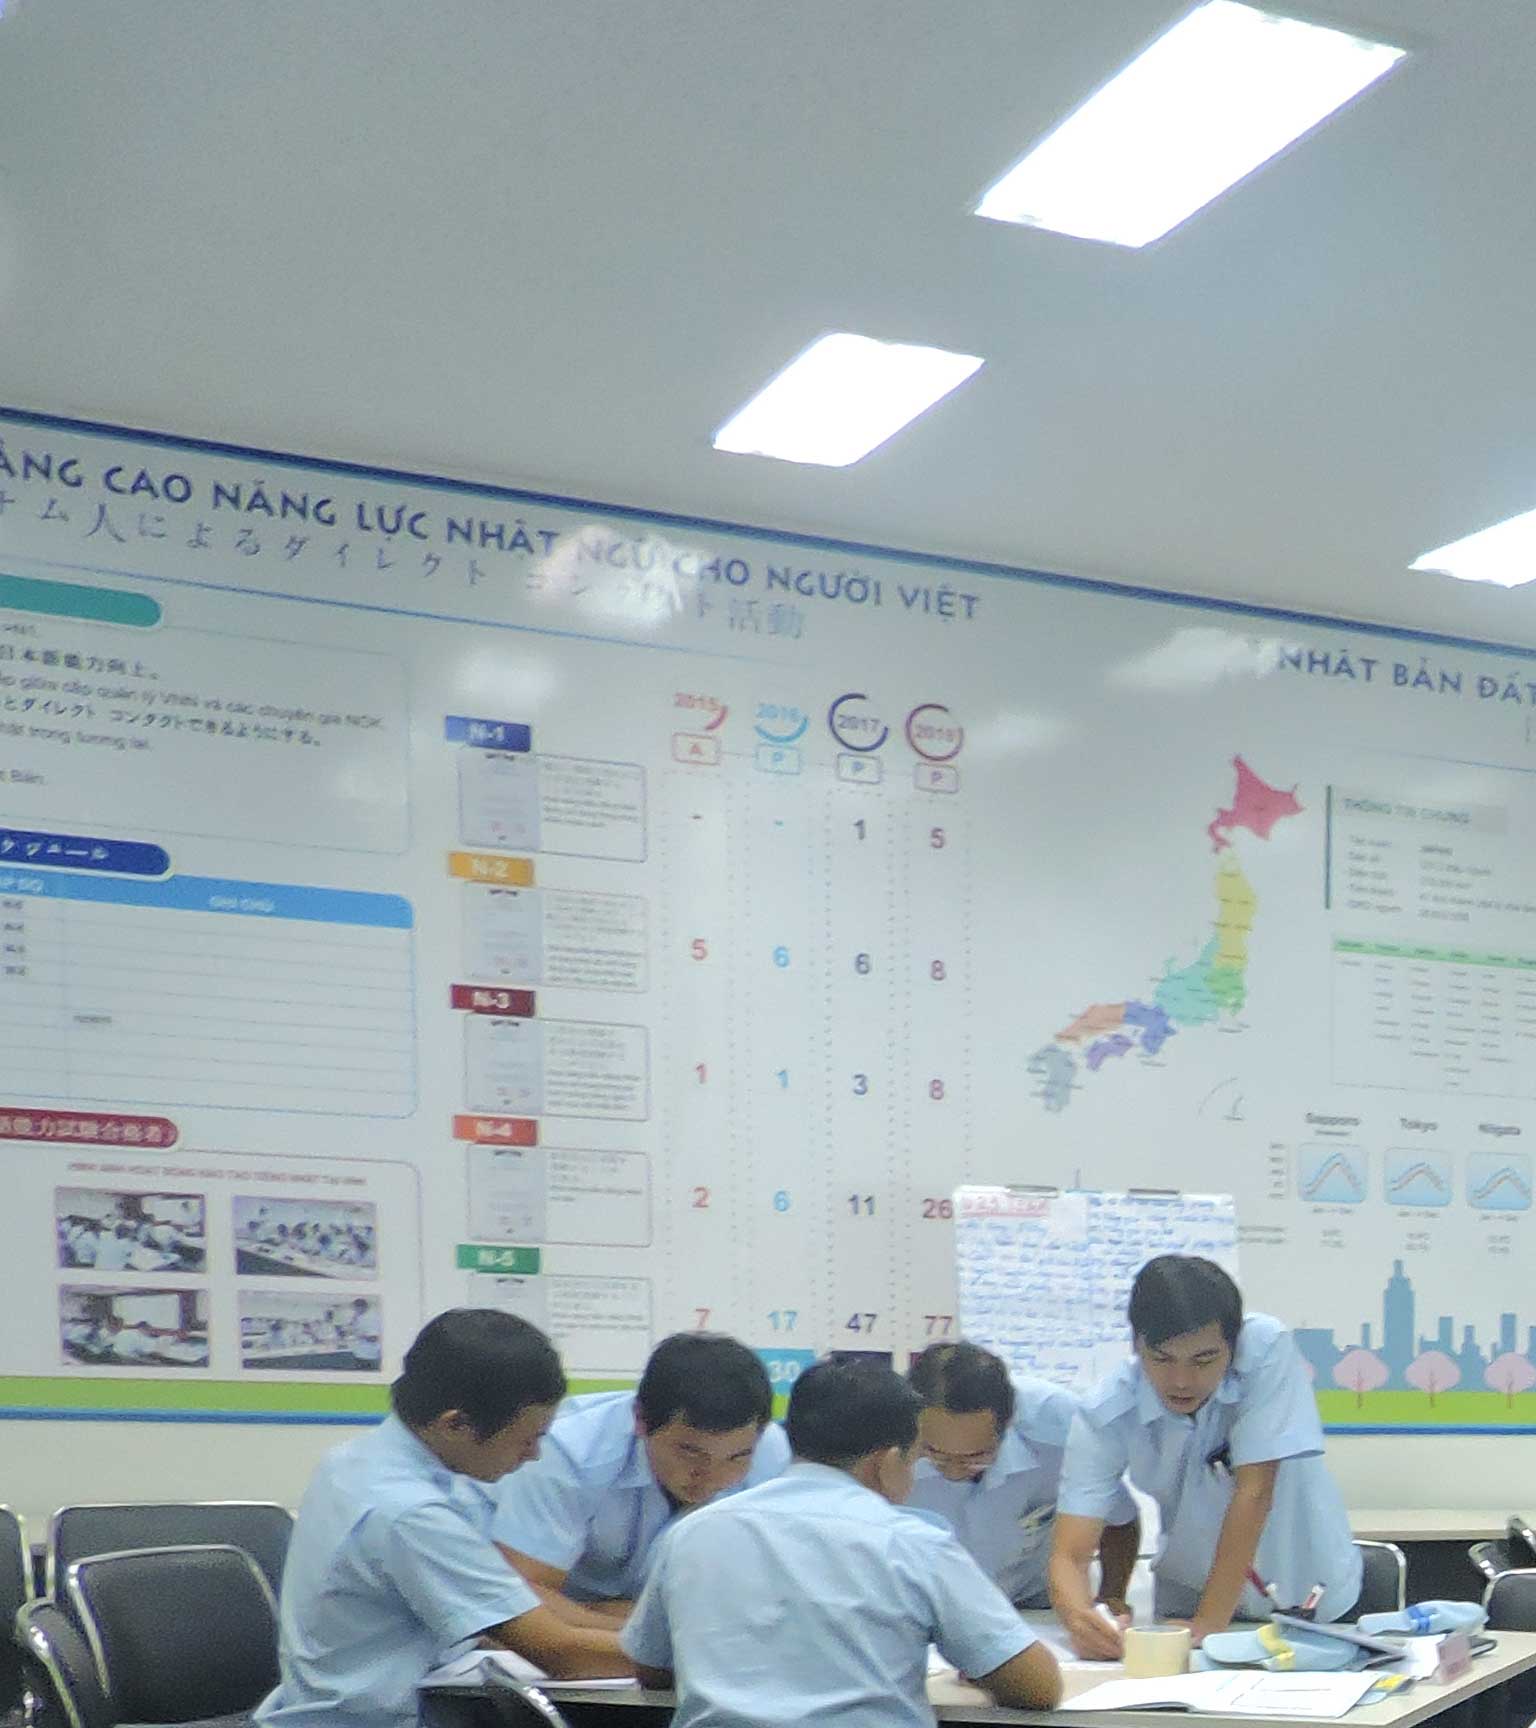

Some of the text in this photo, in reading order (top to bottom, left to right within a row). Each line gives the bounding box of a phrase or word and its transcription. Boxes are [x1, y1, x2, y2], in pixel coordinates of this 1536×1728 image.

[105, 466, 193, 504] CAO
[212, 479, 336, 526] NĂNG
[357, 502, 429, 541] LỰC
[447, 517, 560, 557] NHẬT
[766, 565, 883, 607] NGƯỜI
[897, 580, 982, 625] VIỆT
[1393, 656, 1463, 694] BẢN
[837, 714, 880, 733] 2017
[854, 819, 866, 841] 1
[930, 827, 945, 850] 5
[691, 938, 708, 961] 5
[772, 945, 790, 968] 6
[855, 953, 871, 975] 6
[930, 959, 946, 981] 8
[695, 1063, 708, 1084] 1
[777, 1069, 789, 1089] 1
[853, 1073, 868, 1096] 3
[929, 1079, 945, 1100] 8
[692, 1186, 710, 1209] 2
[773, 1190, 791, 1212] 6
[848, 1194, 876, 1216] 11
[922, 1198, 954, 1220] 26
[695, 1308, 711, 1331] 7
[767, 1310, 798, 1331] 17
[845, 1313, 878, 1334] 47
[923, 1315, 954, 1336] 77
